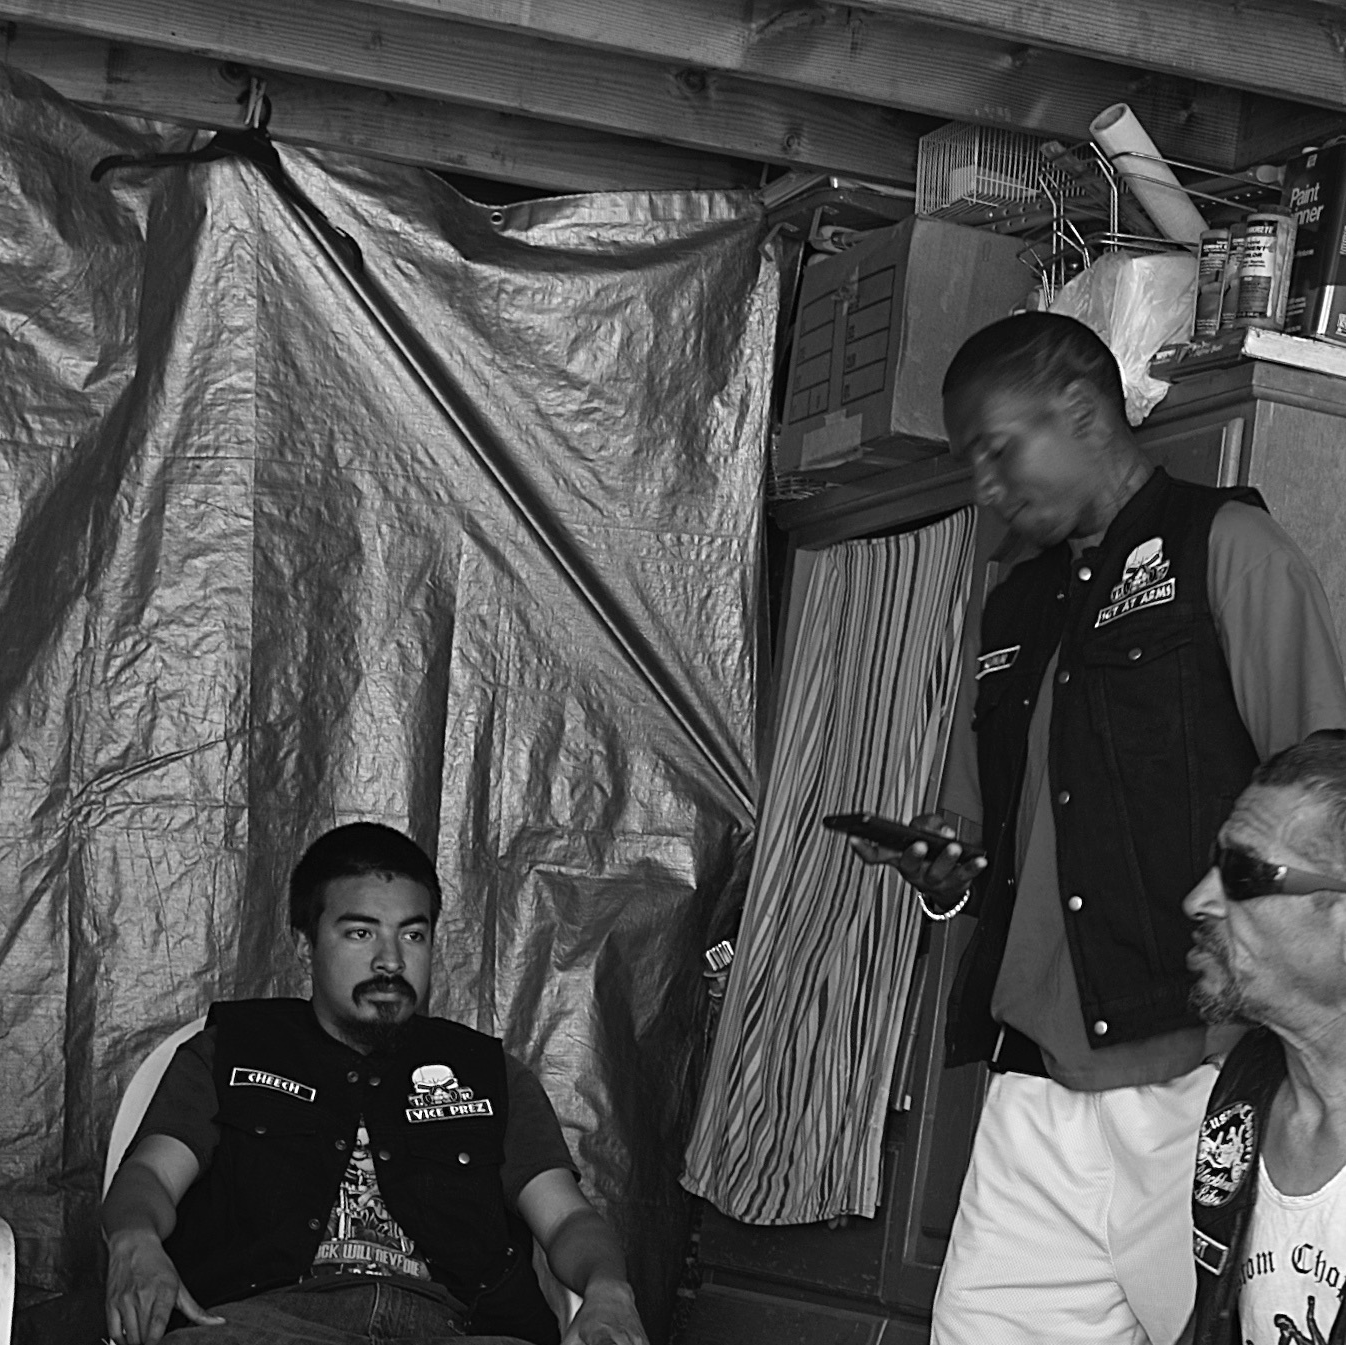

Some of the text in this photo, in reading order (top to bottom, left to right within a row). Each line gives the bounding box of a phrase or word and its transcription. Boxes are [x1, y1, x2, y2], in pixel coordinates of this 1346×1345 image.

[1289, 181, 1320, 208] Paint
[1122, 597, 1138, 613] AT
[248, 1072, 300, 1094] CHEECH
[412, 1103, 486, 1120] VICE PREZ
[342, 1243, 372, 1260] WILL
[402, 1258, 420, 1277] DIE
